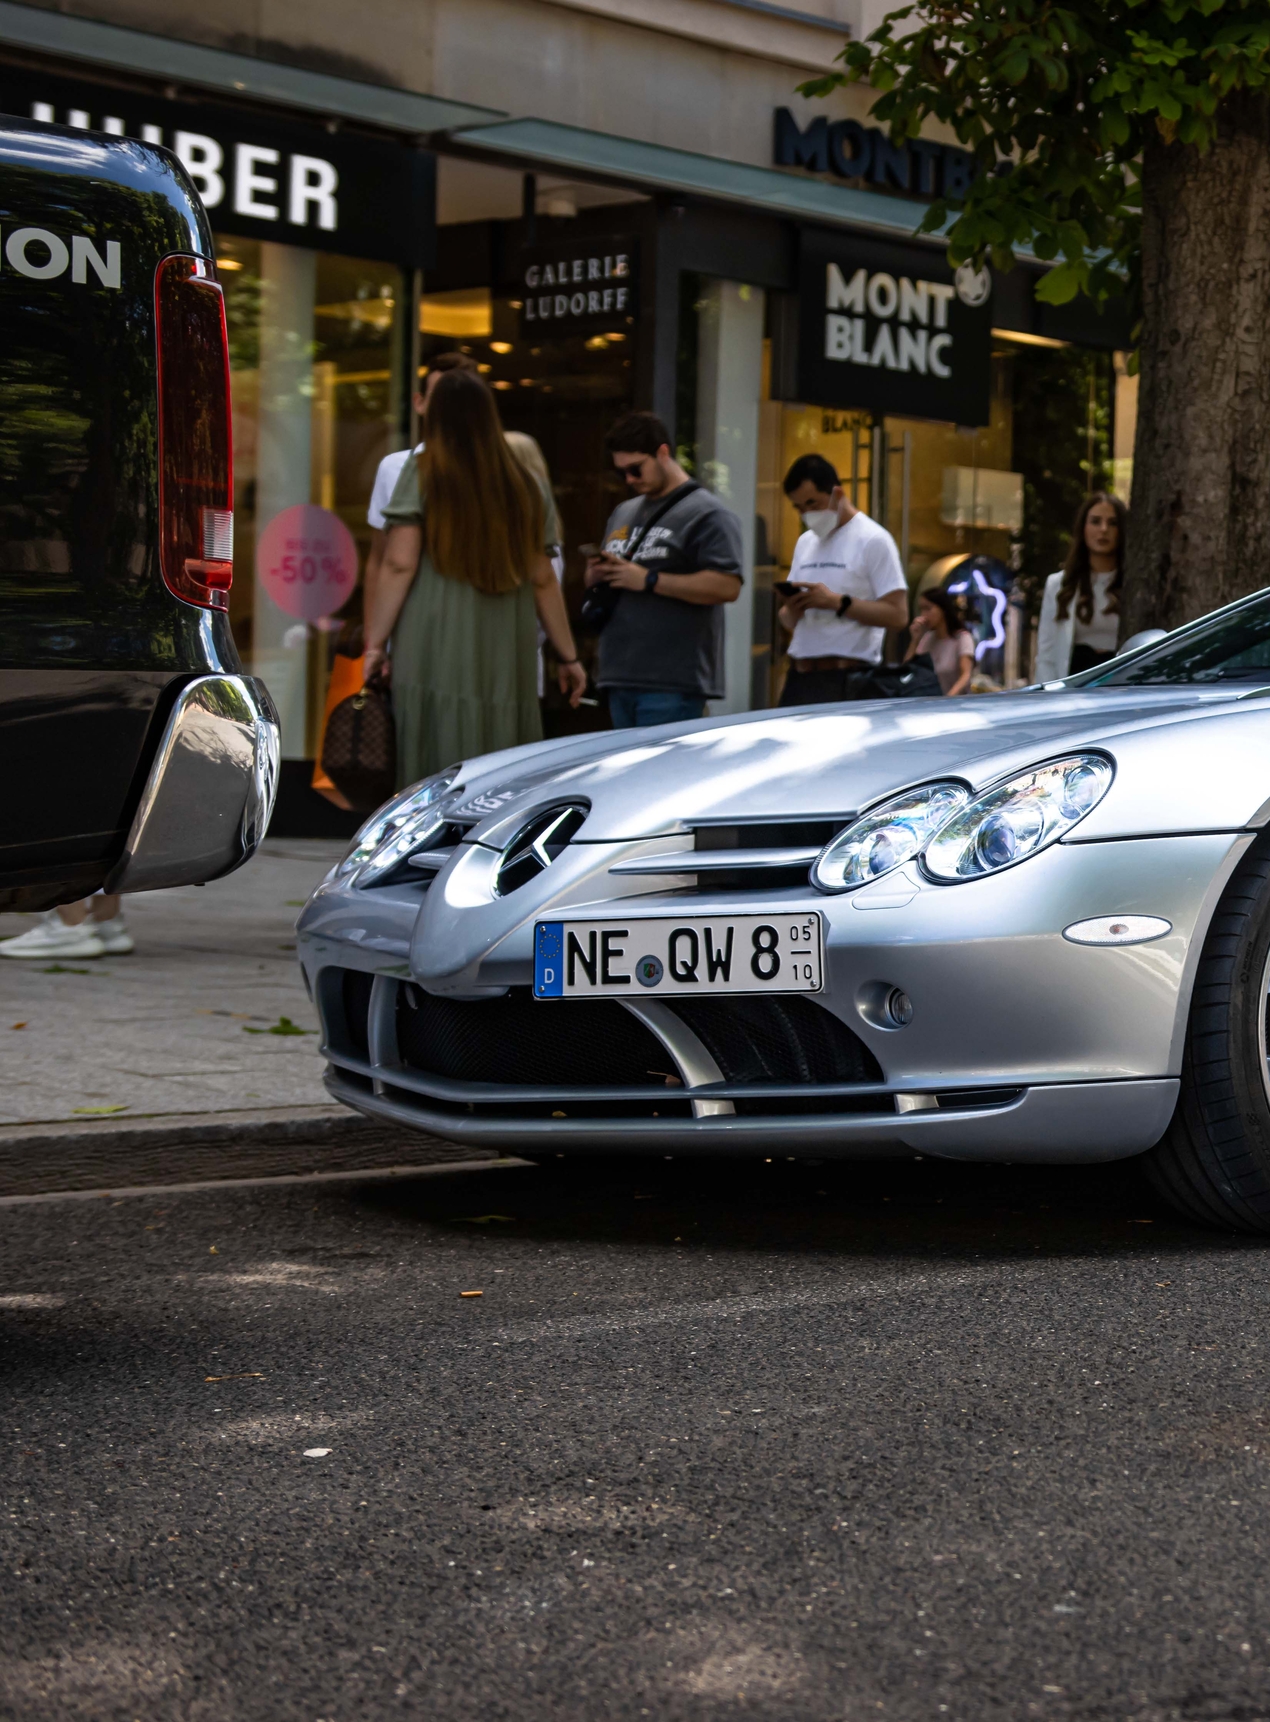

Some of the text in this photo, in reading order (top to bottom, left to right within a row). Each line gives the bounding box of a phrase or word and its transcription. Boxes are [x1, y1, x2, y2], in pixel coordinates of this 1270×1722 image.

[32, 101, 338, 231] BER
[0, 224, 121, 289] ON
[525, 253, 629, 288] GALERIE
[525, 287, 628, 320] LUDORFF
[825, 262, 955, 329] MONT
[825, 313, 953, 379] BLANC
[270, 556, 347, 584] -50%
[790, 925, 812, 941] 05
[567, 925, 780, 986] NE QW 8
[792, 963, 813, 980] 10
[544, 968, 554, 983] D
